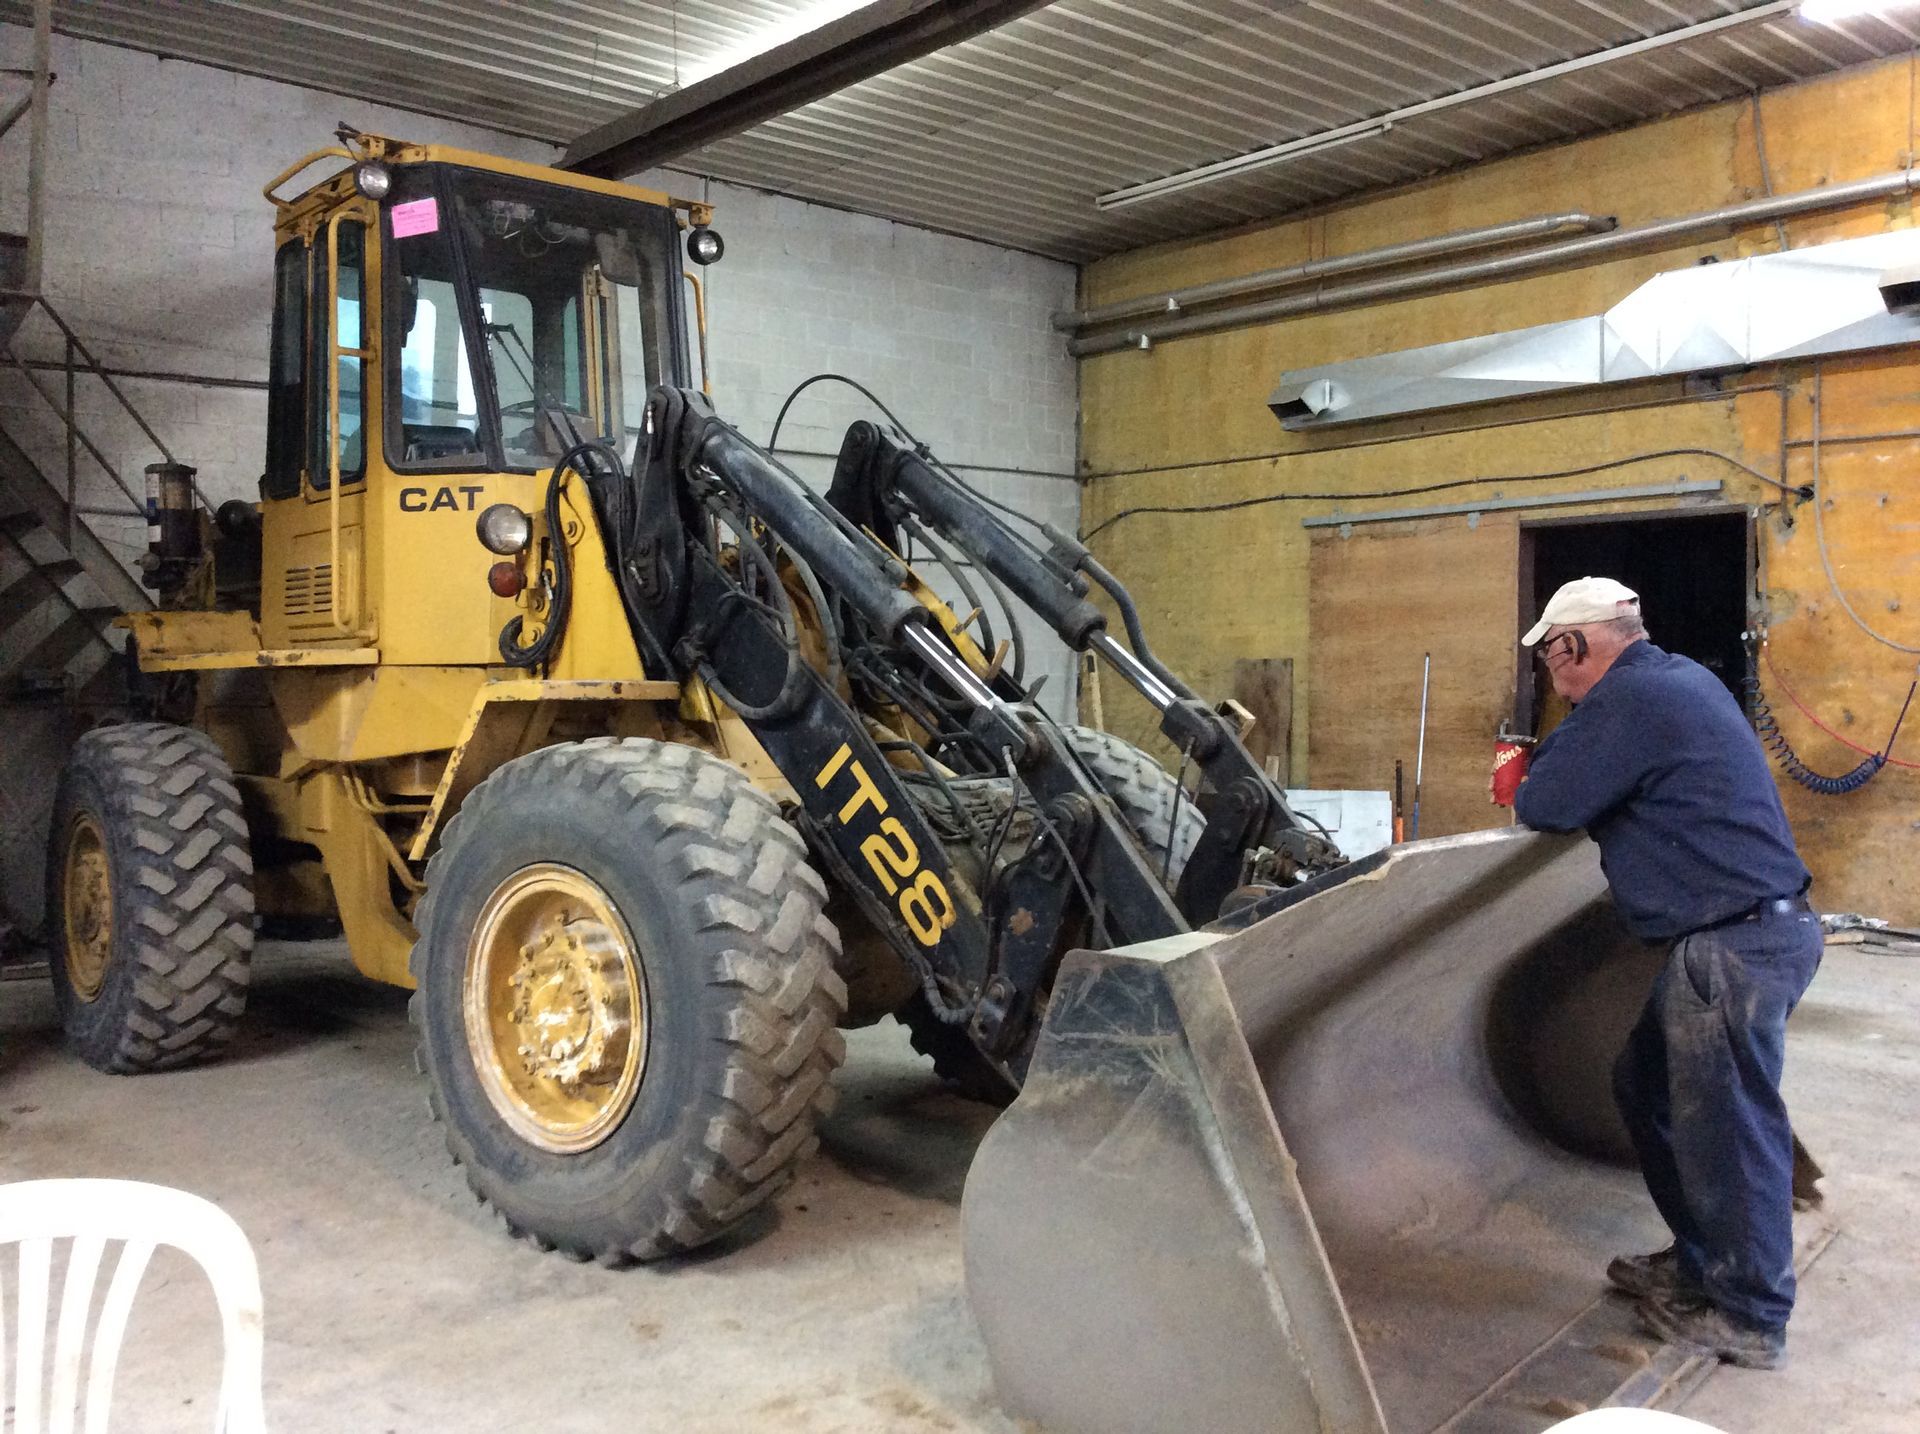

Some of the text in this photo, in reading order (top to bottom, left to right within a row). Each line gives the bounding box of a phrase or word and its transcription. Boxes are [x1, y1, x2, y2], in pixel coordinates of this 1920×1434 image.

[400, 486, 484, 512] CAT
[1494, 745, 1523, 772] tons
[815, 742, 957, 947] IT28
